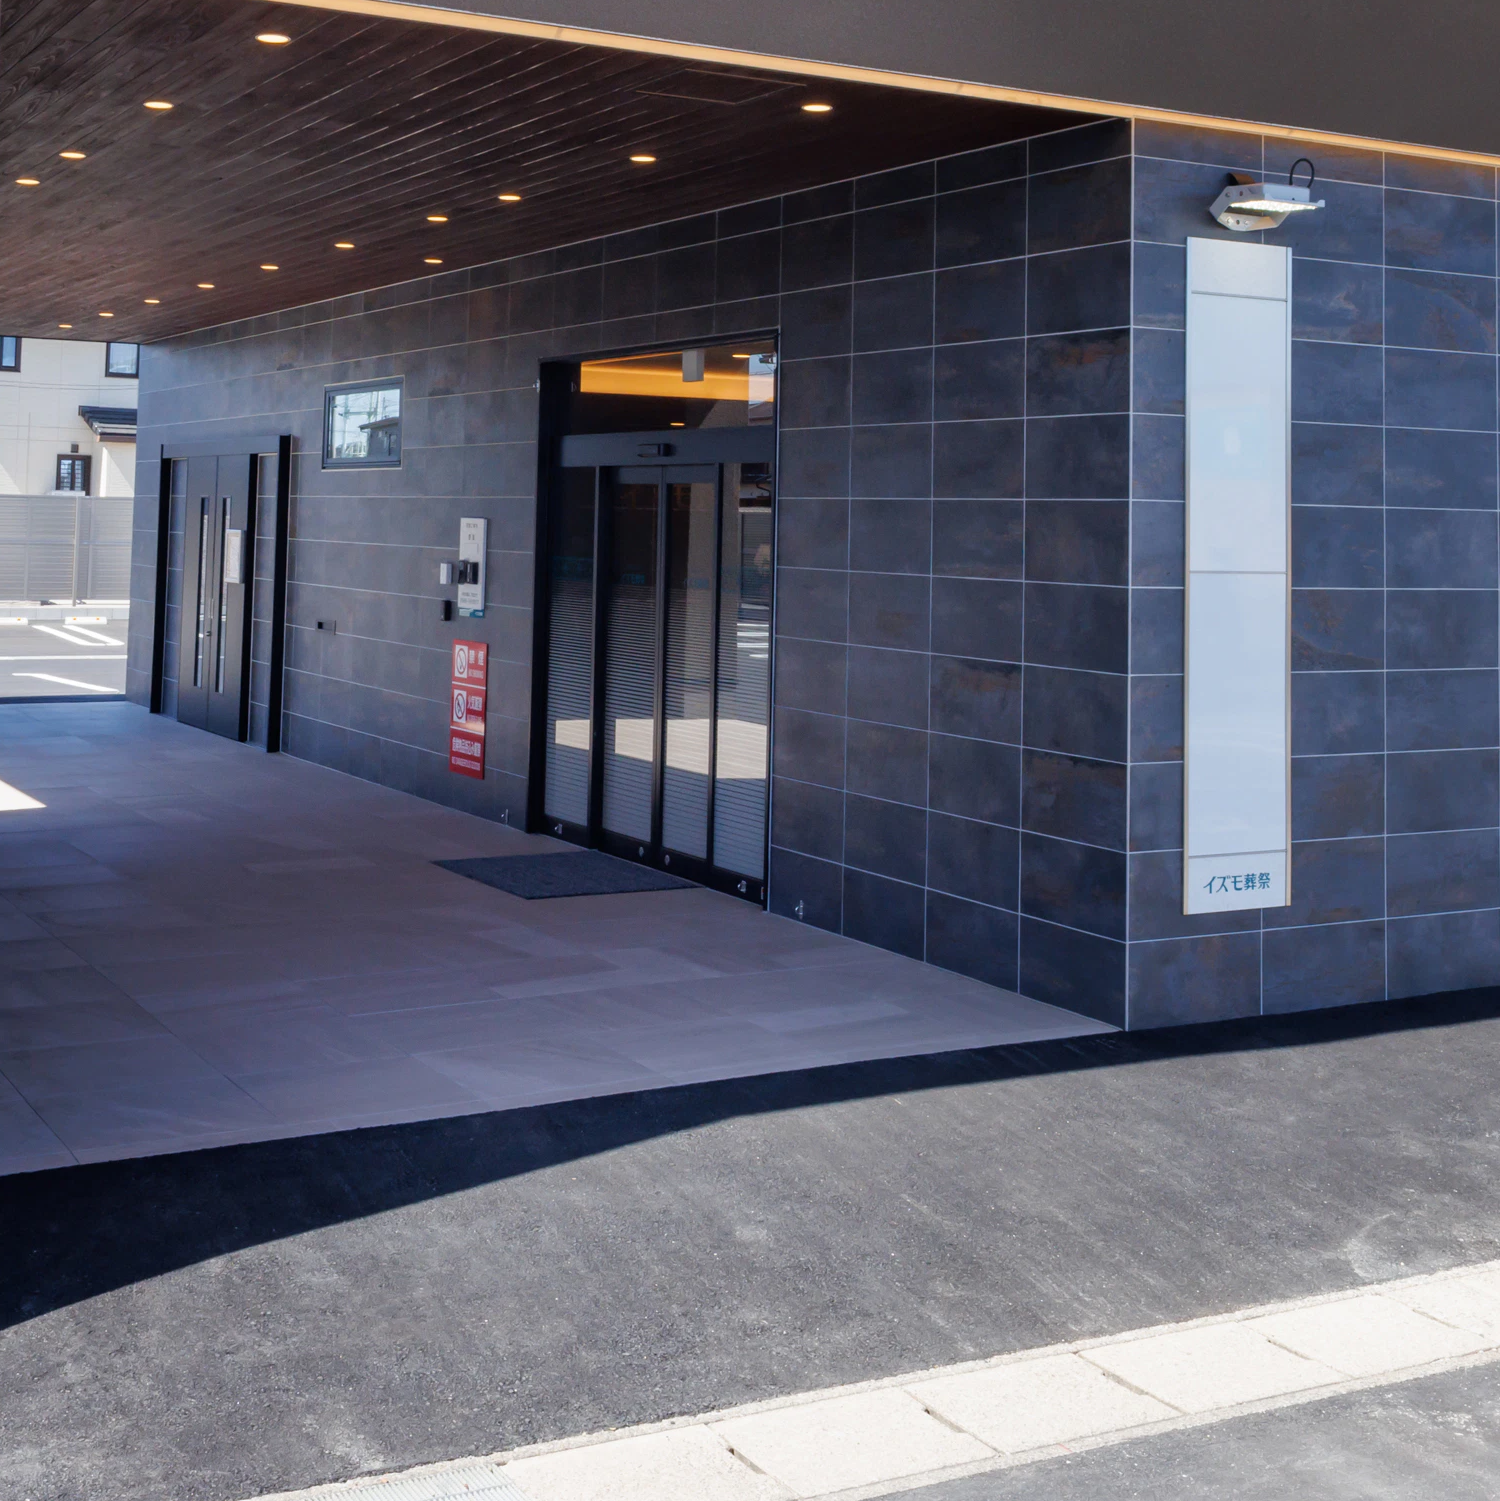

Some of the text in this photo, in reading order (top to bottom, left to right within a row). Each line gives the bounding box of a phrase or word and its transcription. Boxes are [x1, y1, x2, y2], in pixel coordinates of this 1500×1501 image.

[1203, 872, 1271, 895] イズモ葬祭
